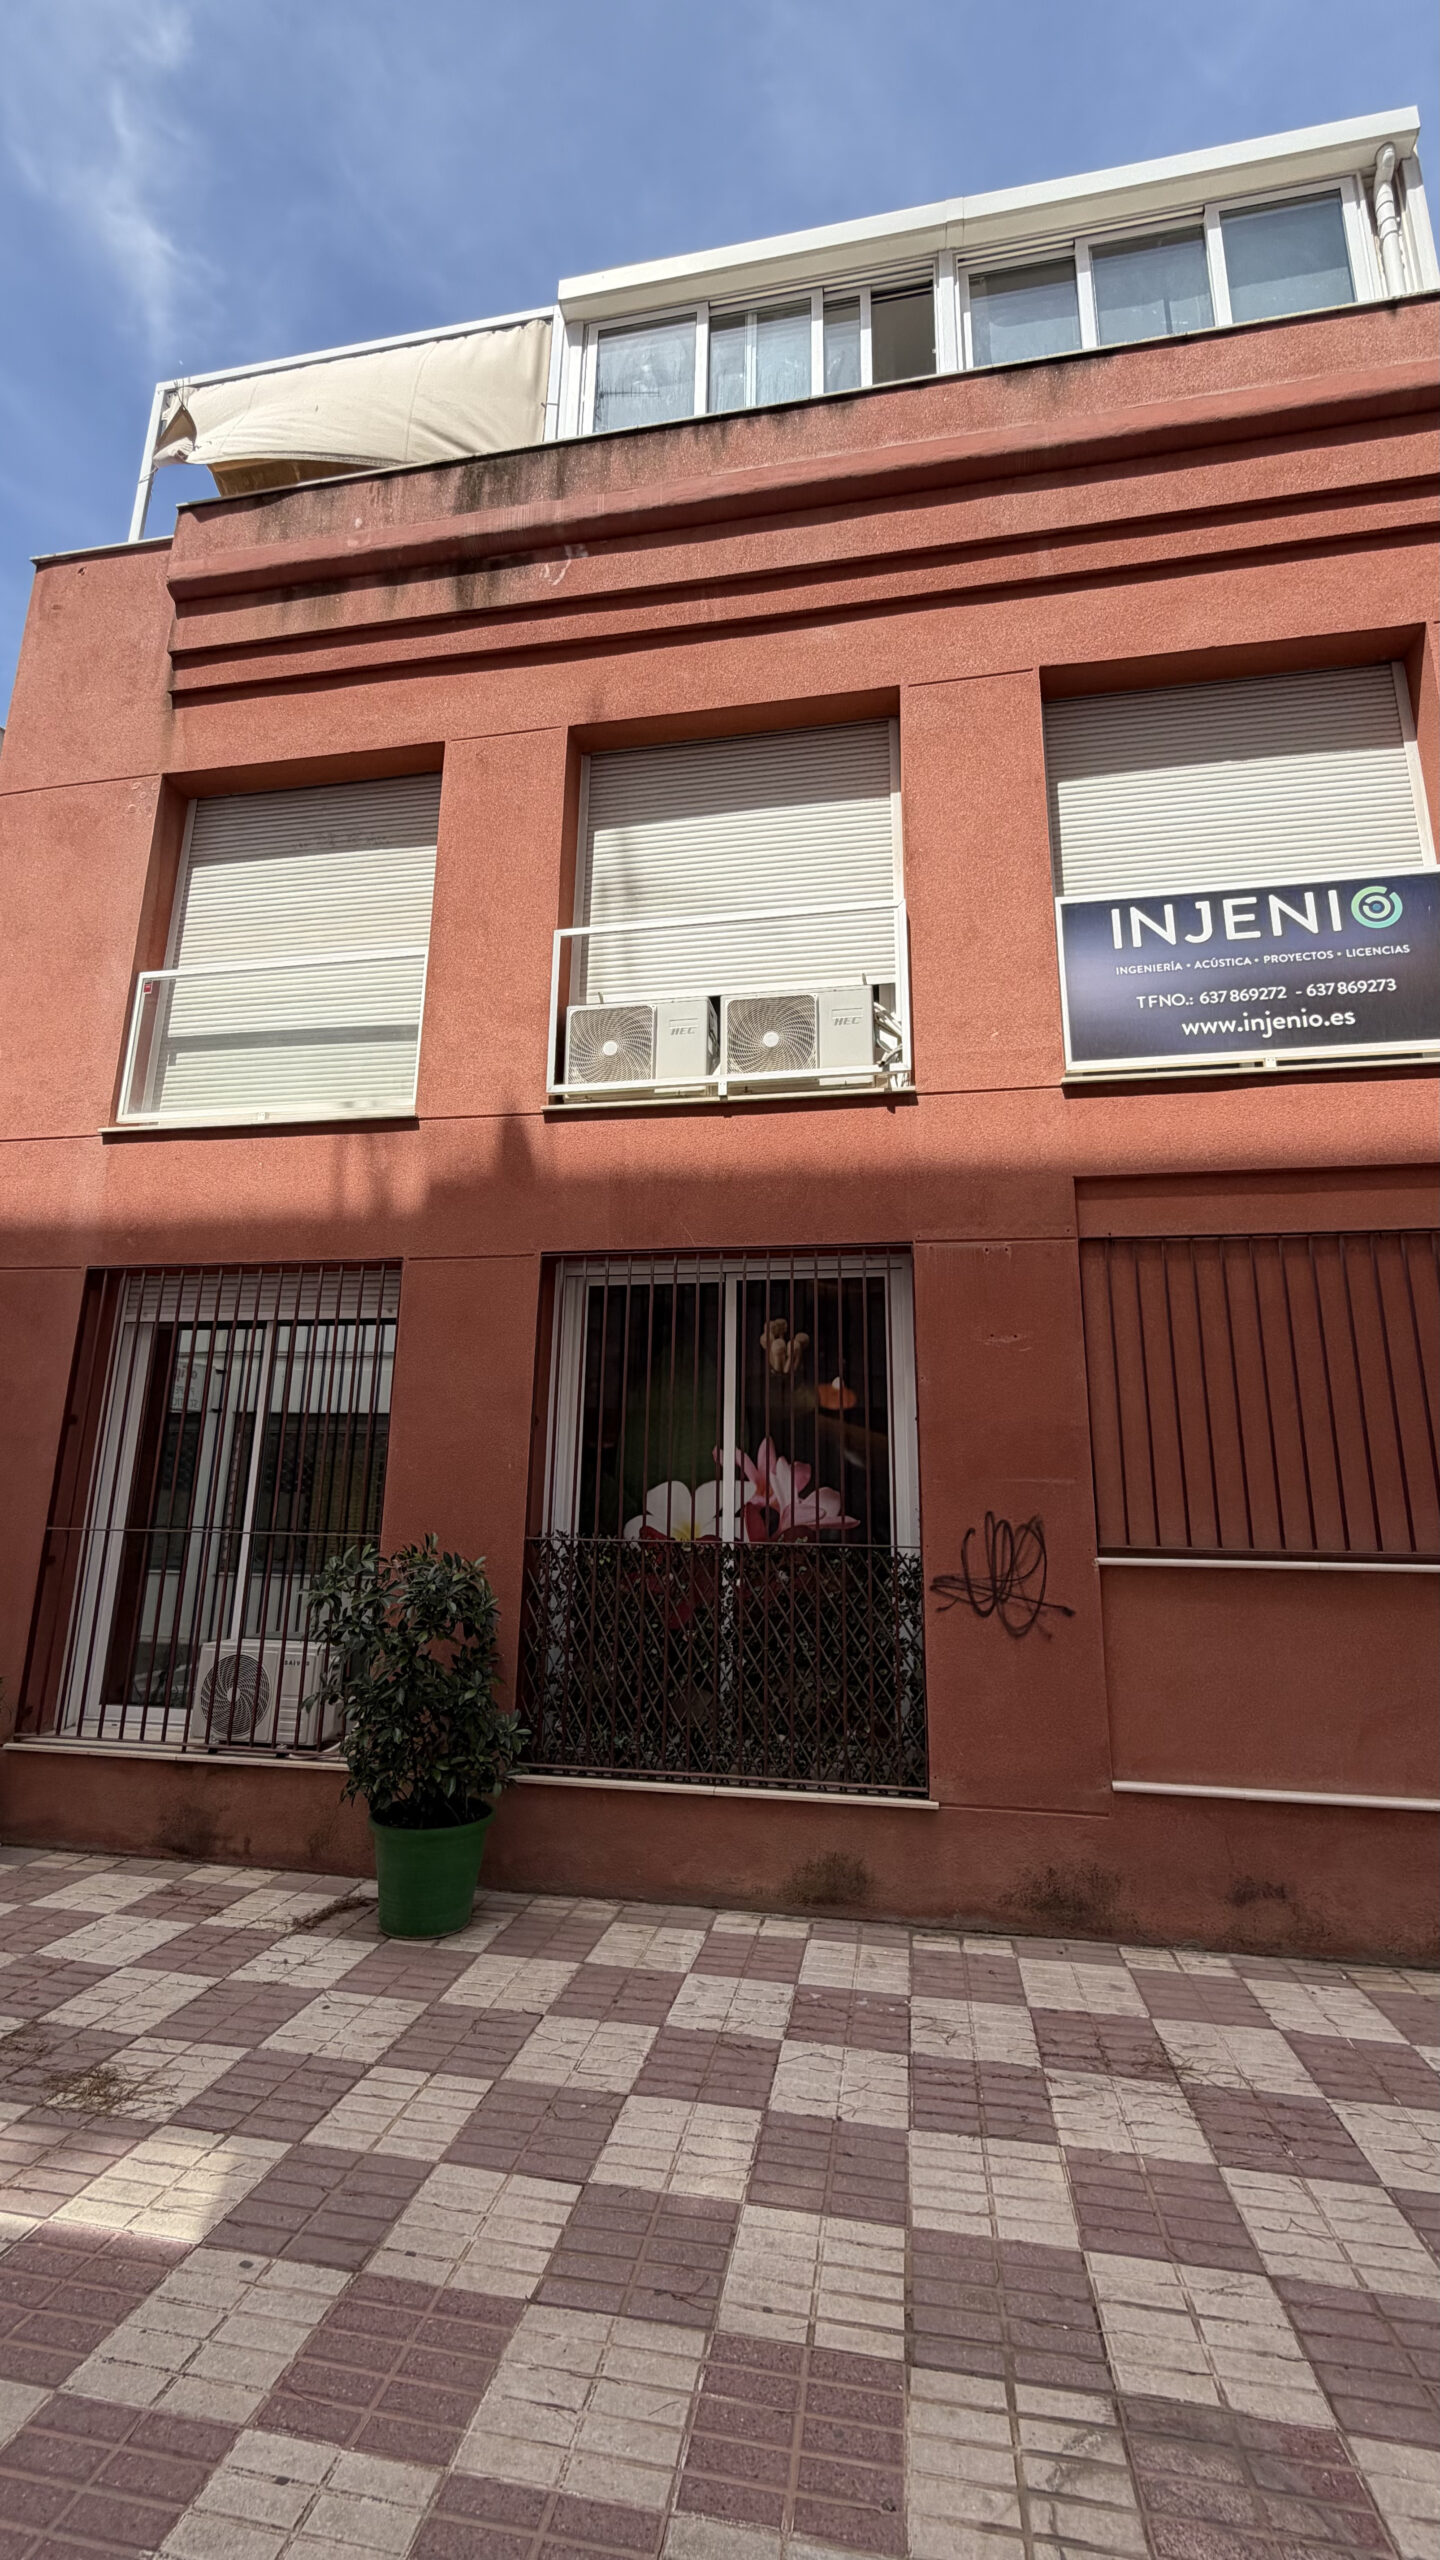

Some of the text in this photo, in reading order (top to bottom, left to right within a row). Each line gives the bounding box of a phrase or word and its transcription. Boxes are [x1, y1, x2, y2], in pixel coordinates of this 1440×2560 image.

[1110, 885, 1403, 950] INJENIO
[1116, 944, 1411, 975] INGENIERÍA ACÚSTICA PROYECTOS LICENCIAS
[1181, 1008, 1356, 1038] www.injenio.es
